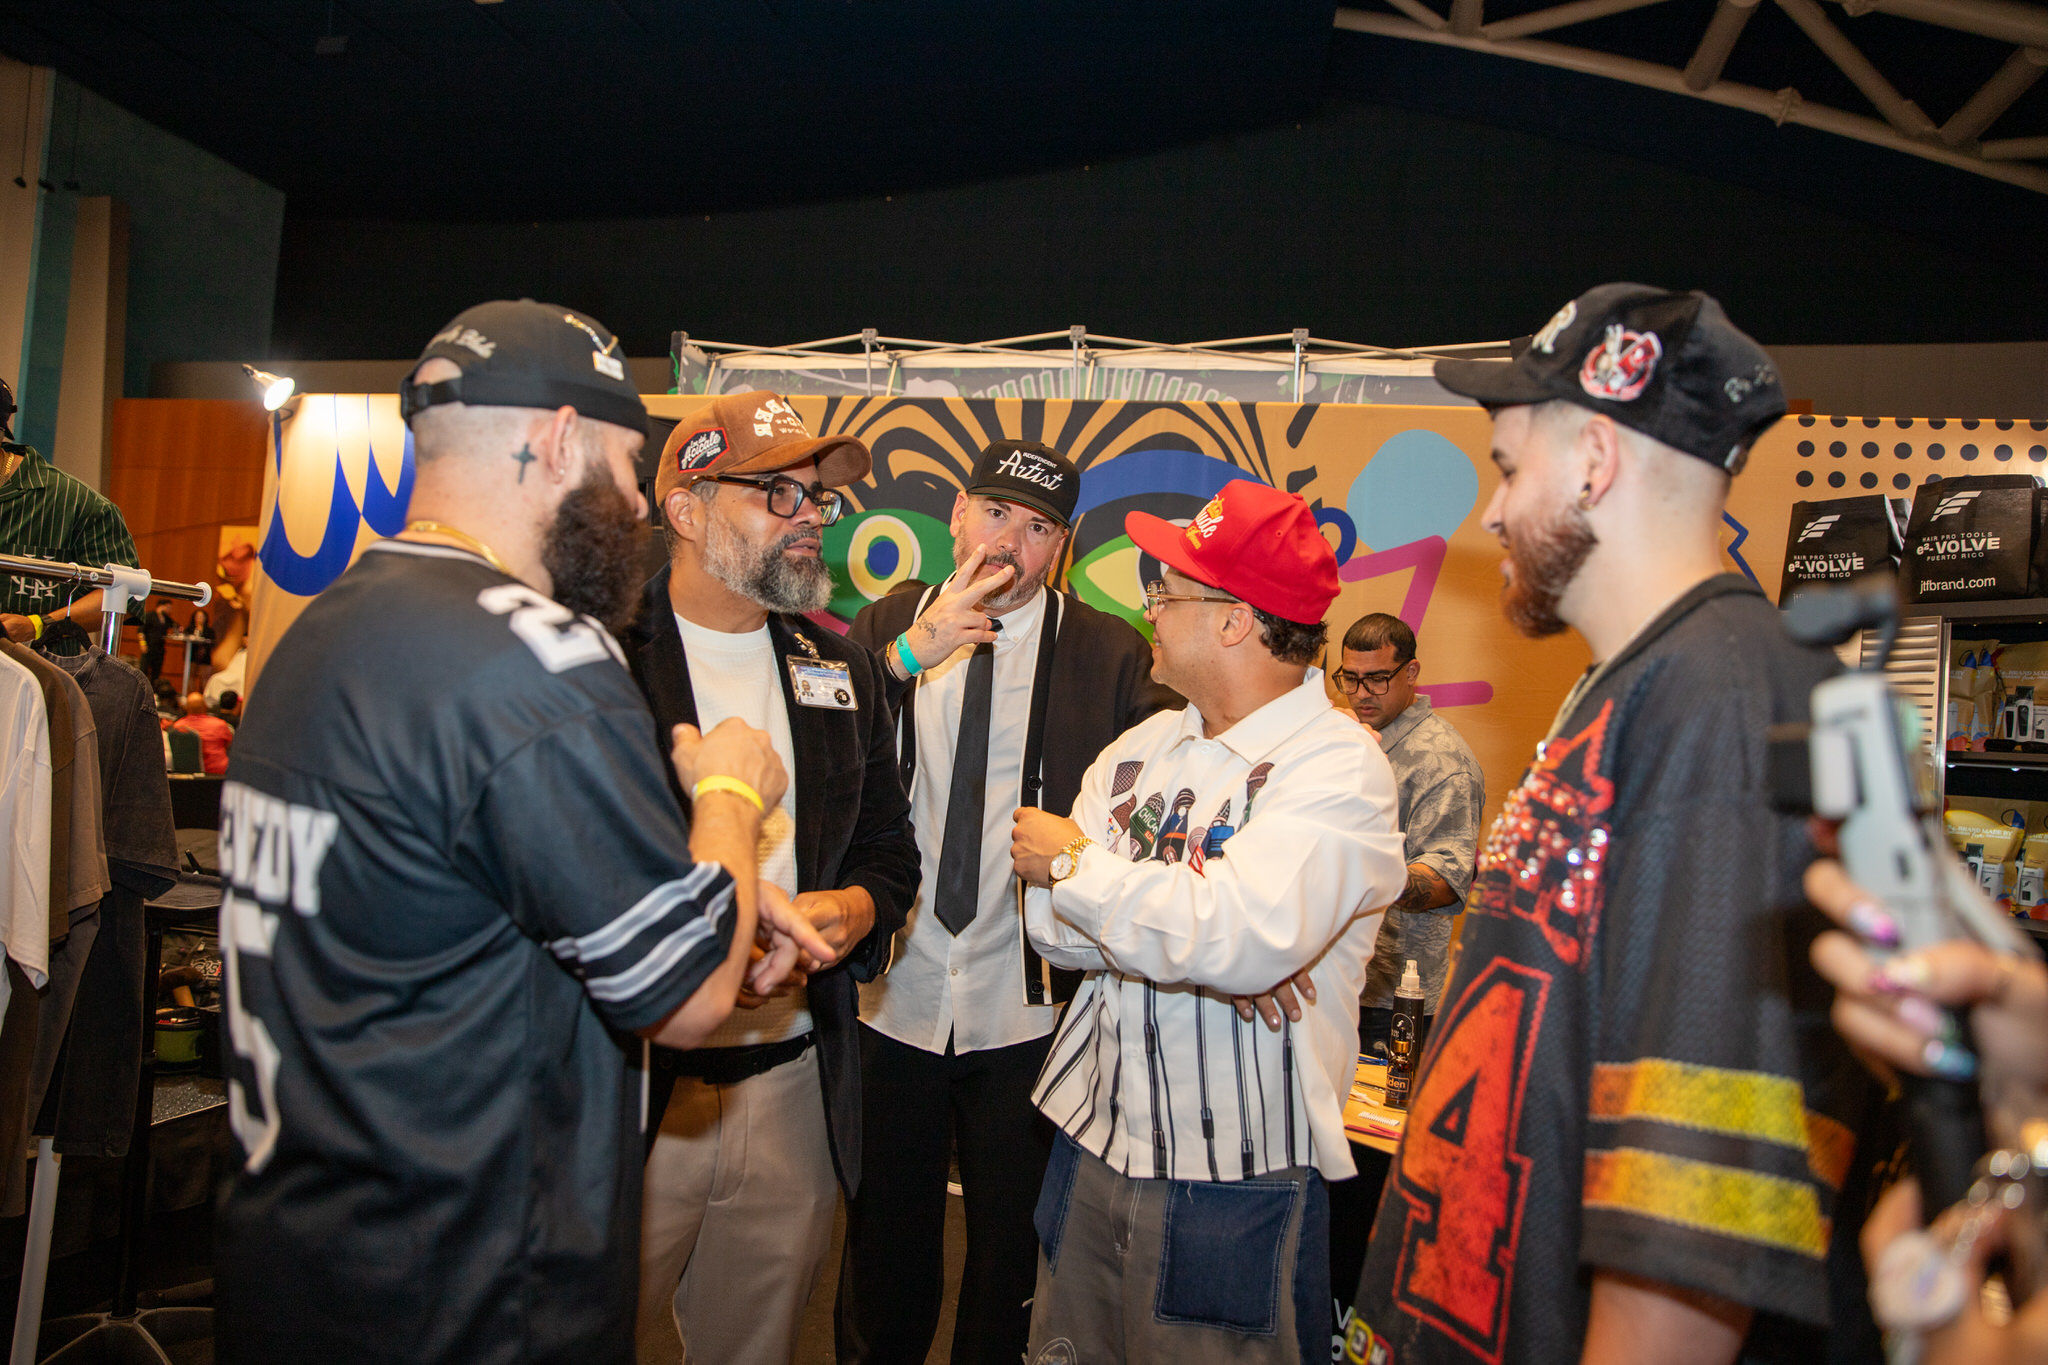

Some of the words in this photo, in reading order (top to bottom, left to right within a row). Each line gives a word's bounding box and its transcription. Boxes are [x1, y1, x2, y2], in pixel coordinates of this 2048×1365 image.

[1022, 452, 1057, 469] INDEPENDENT
[995, 449, 1064, 491] Artist
[1960, 531, 1993, 539] TOOLS
[1828, 551, 1857, 560] TOOLS
[1926, 553, 1957, 562] PUERTO
[1961, 551, 1985, 559] RICO
[1919, 577, 1997, 595] jtfbrand.com
[1393, 956, 1552, 1364] 4
